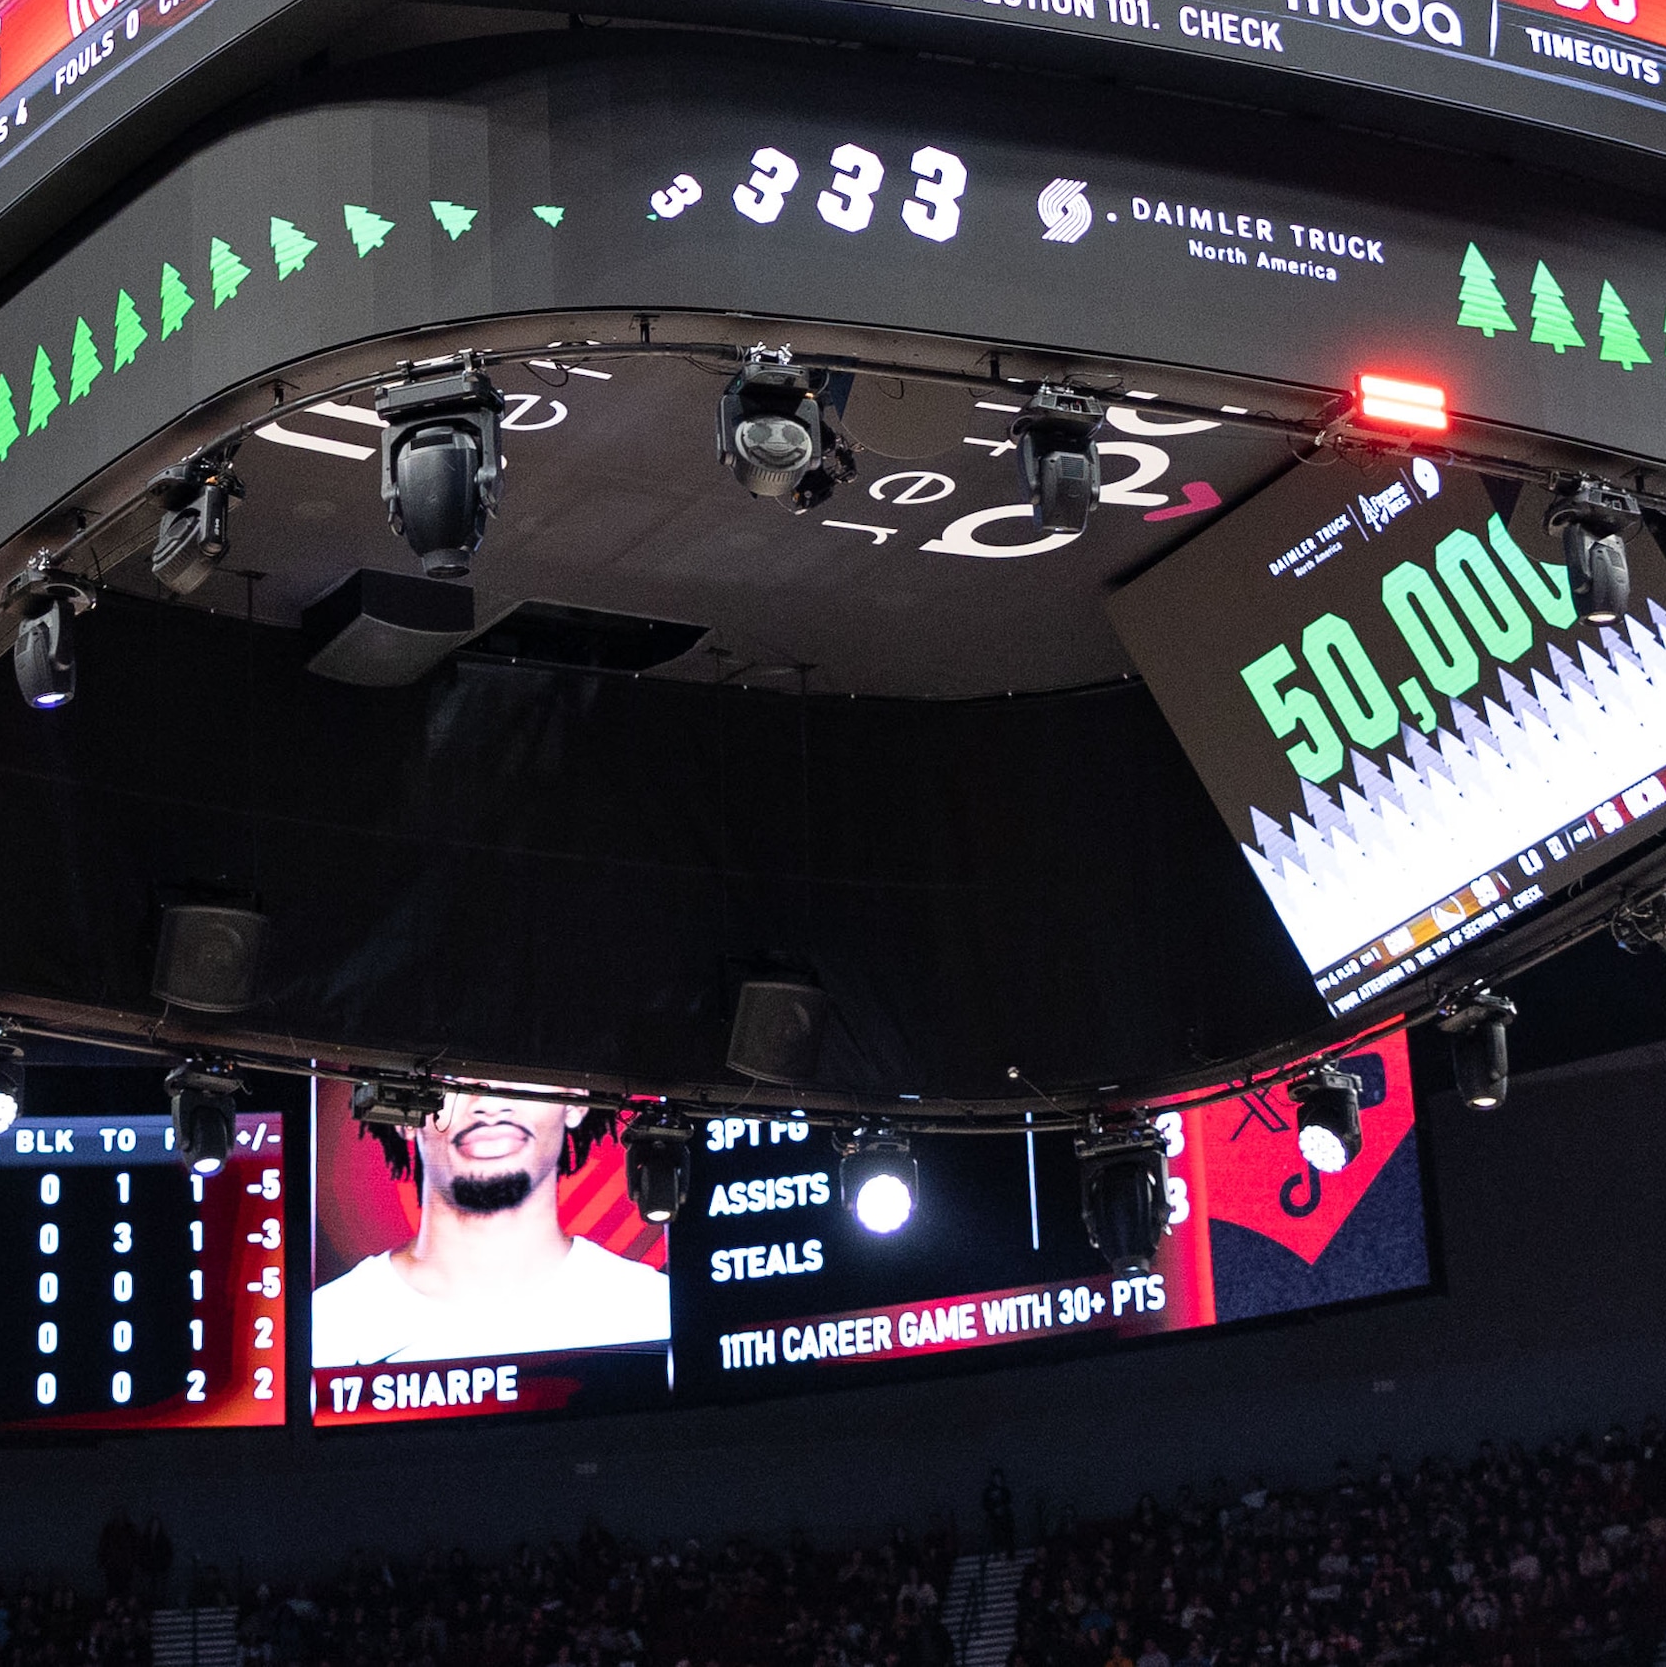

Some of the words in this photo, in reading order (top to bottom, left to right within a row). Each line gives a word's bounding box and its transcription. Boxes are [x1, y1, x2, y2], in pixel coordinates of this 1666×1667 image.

[1179, 5, 1284, 53] CHECK
[15, 96, 28, 126] 4
[53, 29, 115, 95] FOULS
[125, 8, 140, 40] 0
[1525, 27, 1661, 85] TIMEOUTS
[1132, 197, 1274, 242] DAIMLER
[1289, 224, 1384, 264] TRUCK
[1188, 239, 1247, 265] North
[1256, 251, 1337, 282] America
[1268, 537, 1317, 577] DAIMLER
[1315, 514, 1351, 543] TRUCK
[15, 1129, 74, 1153] BLK
[99, 1128, 137, 1152] TO
[236, 1122, 281, 1152] +/-
[707, 1118, 760, 1151] 3PT
[116, 1172, 130, 1204] 1
[190, 1173, 203, 1202] 1
[246, 1168, 281, 1200] -5
[708, 1172, 830, 1217] ASSISTS
[113, 1222, 132, 1253] 3
[189, 1220, 203, 1252] 1
[247, 1218, 281, 1250] -3
[711, 1239, 824, 1282] STEALS
[189, 1269, 203, 1301] 1
[246, 1266, 282, 1299] -5
[189, 1319, 203, 1351] 1
[254, 1316, 274, 1349] 2
[719, 1329, 776, 1369] 11TH
[782, 1315, 893, 1362] CAREER
[898, 1303, 978, 1348] GAME
[981, 1291, 1052, 1336] WITH
[1058, 1288, 1106, 1325] 30+
[1112, 1274, 1166, 1316] PTS
[186, 1369, 206, 1402] 2
[253, 1367, 274, 1400] 2
[329, 1376, 363, 1413] 17
[372, 1365, 518, 1411] SHARPE
